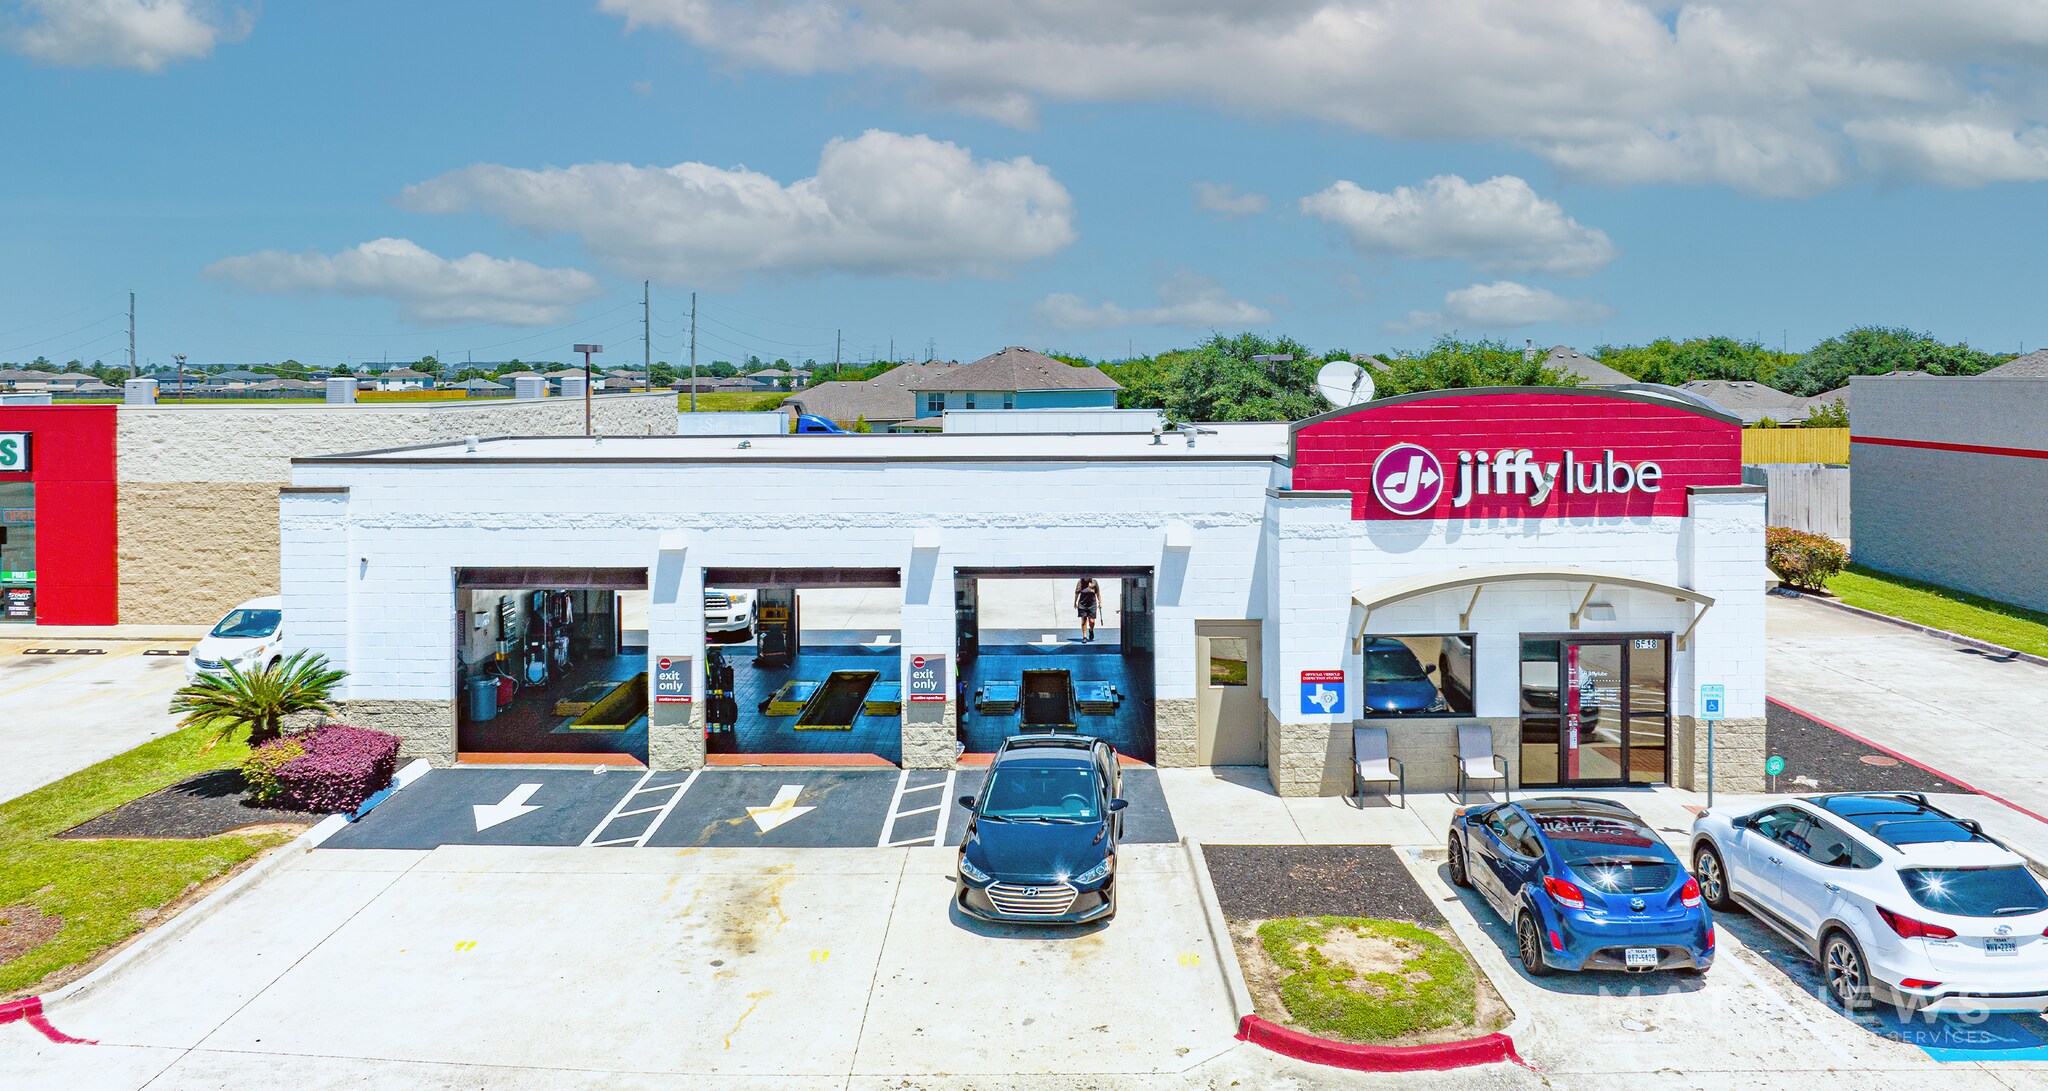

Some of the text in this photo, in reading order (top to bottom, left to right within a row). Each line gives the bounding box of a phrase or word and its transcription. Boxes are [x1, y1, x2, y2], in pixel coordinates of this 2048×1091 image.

[659, 670, 680, 681] exit
[913, 669, 934, 679] exit
[659, 680, 683, 693] only
[913, 679, 938, 691] only
